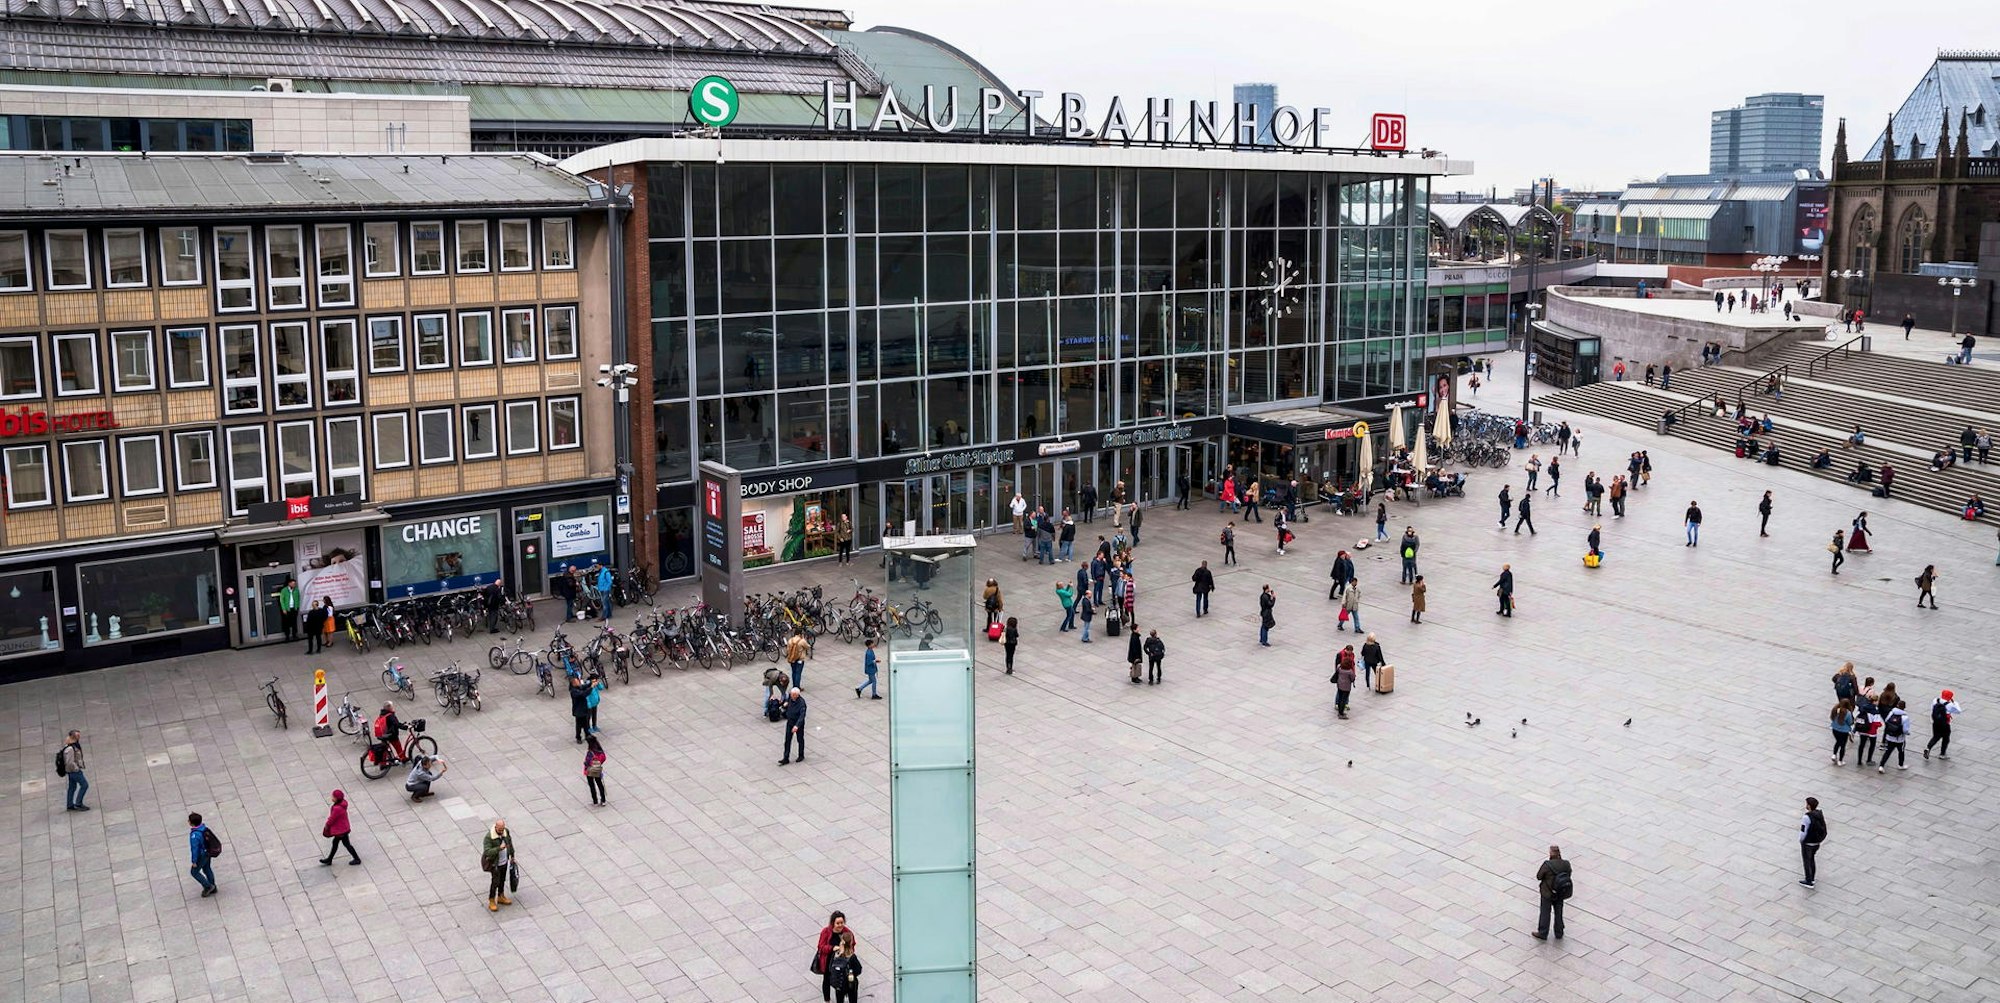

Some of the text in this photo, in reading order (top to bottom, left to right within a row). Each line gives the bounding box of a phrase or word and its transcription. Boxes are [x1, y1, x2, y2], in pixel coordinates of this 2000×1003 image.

[701, 81, 730, 122] S
[823, 79, 1331, 149] HAUPTBAHNHOF
[1377, 118, 1403, 145] DB
[1065, 335, 1104, 345] STARBUCS
[51, 411, 120, 432] HOTEL
[1325, 428, 1353, 440] Kamps
[740, 476, 813, 497] BODY SHOP
[290, 503, 309, 514] ibis
[402, 515, 481, 543] CHANGE
[558, 523, 583, 531] Change
[743, 525, 763, 534] SALE
